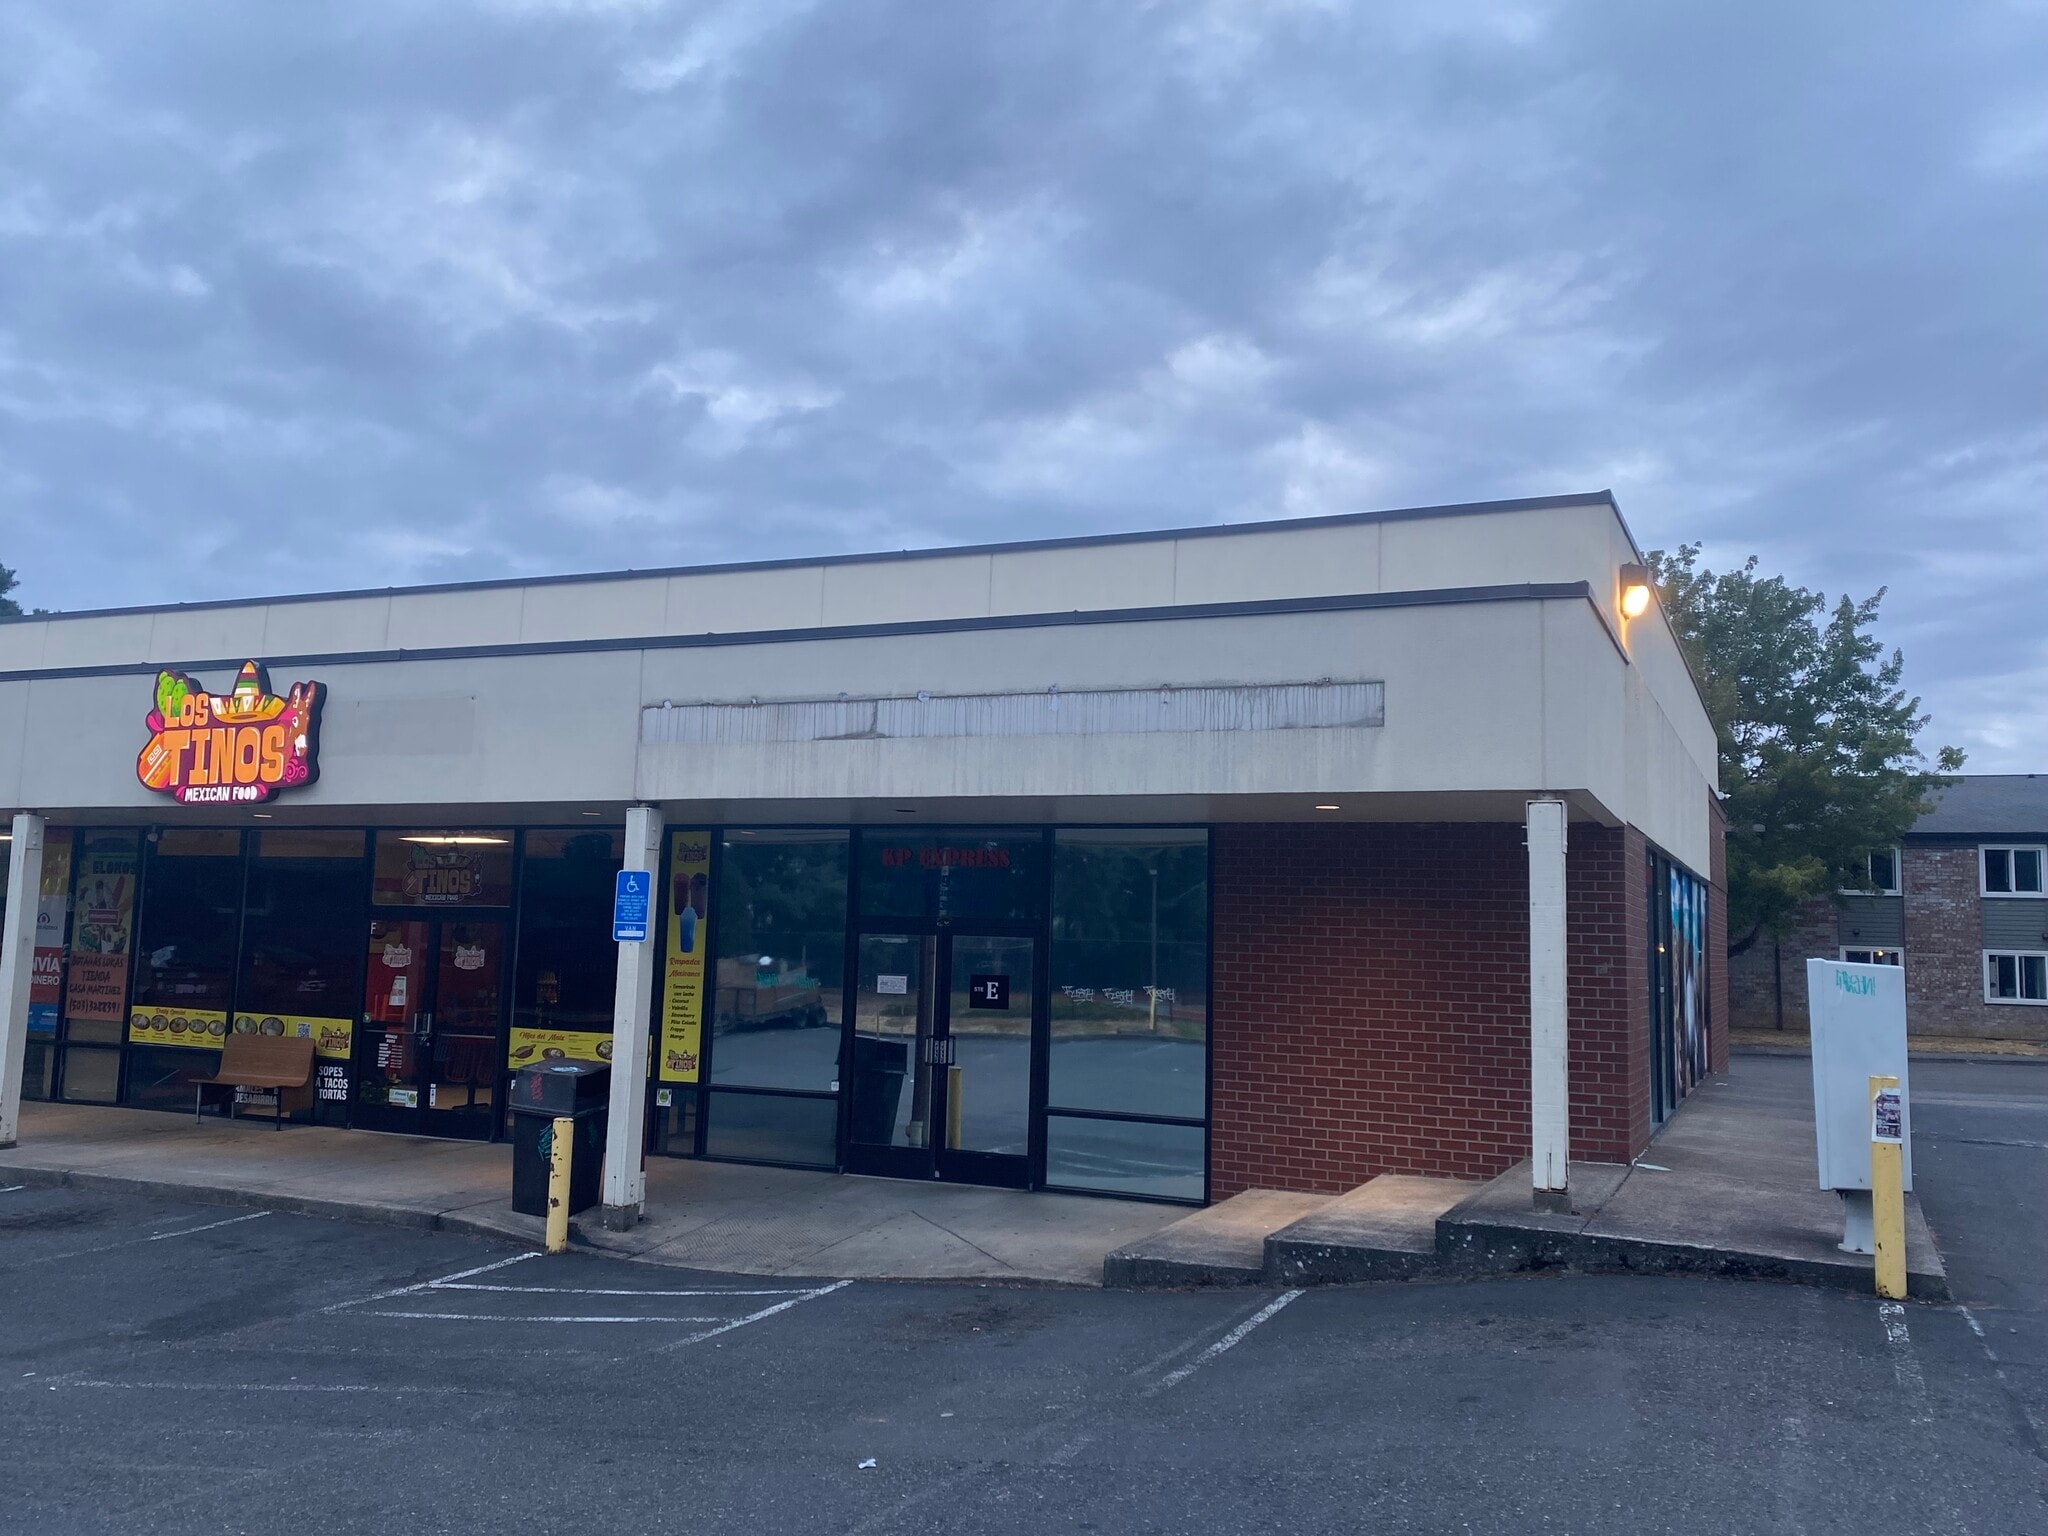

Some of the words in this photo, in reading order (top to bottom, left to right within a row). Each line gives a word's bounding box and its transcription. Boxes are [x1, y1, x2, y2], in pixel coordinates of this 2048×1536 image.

[164, 693, 209, 728] LOS
[163, 726, 285, 786] TINOS
[184, 786, 230, 802] MEXICAN
[232, 785, 258, 801] FOOD
[881, 848, 912, 867] KP
[919, 848, 1010, 868] EXPRESS
[415, 868, 471, 894] TINOS
[986, 981, 999, 1000] E
[318, 1065, 344, 1077] SOPES
[324, 1078, 348, 1090] TACOS
[319, 1088, 347, 1101] TORTAS
